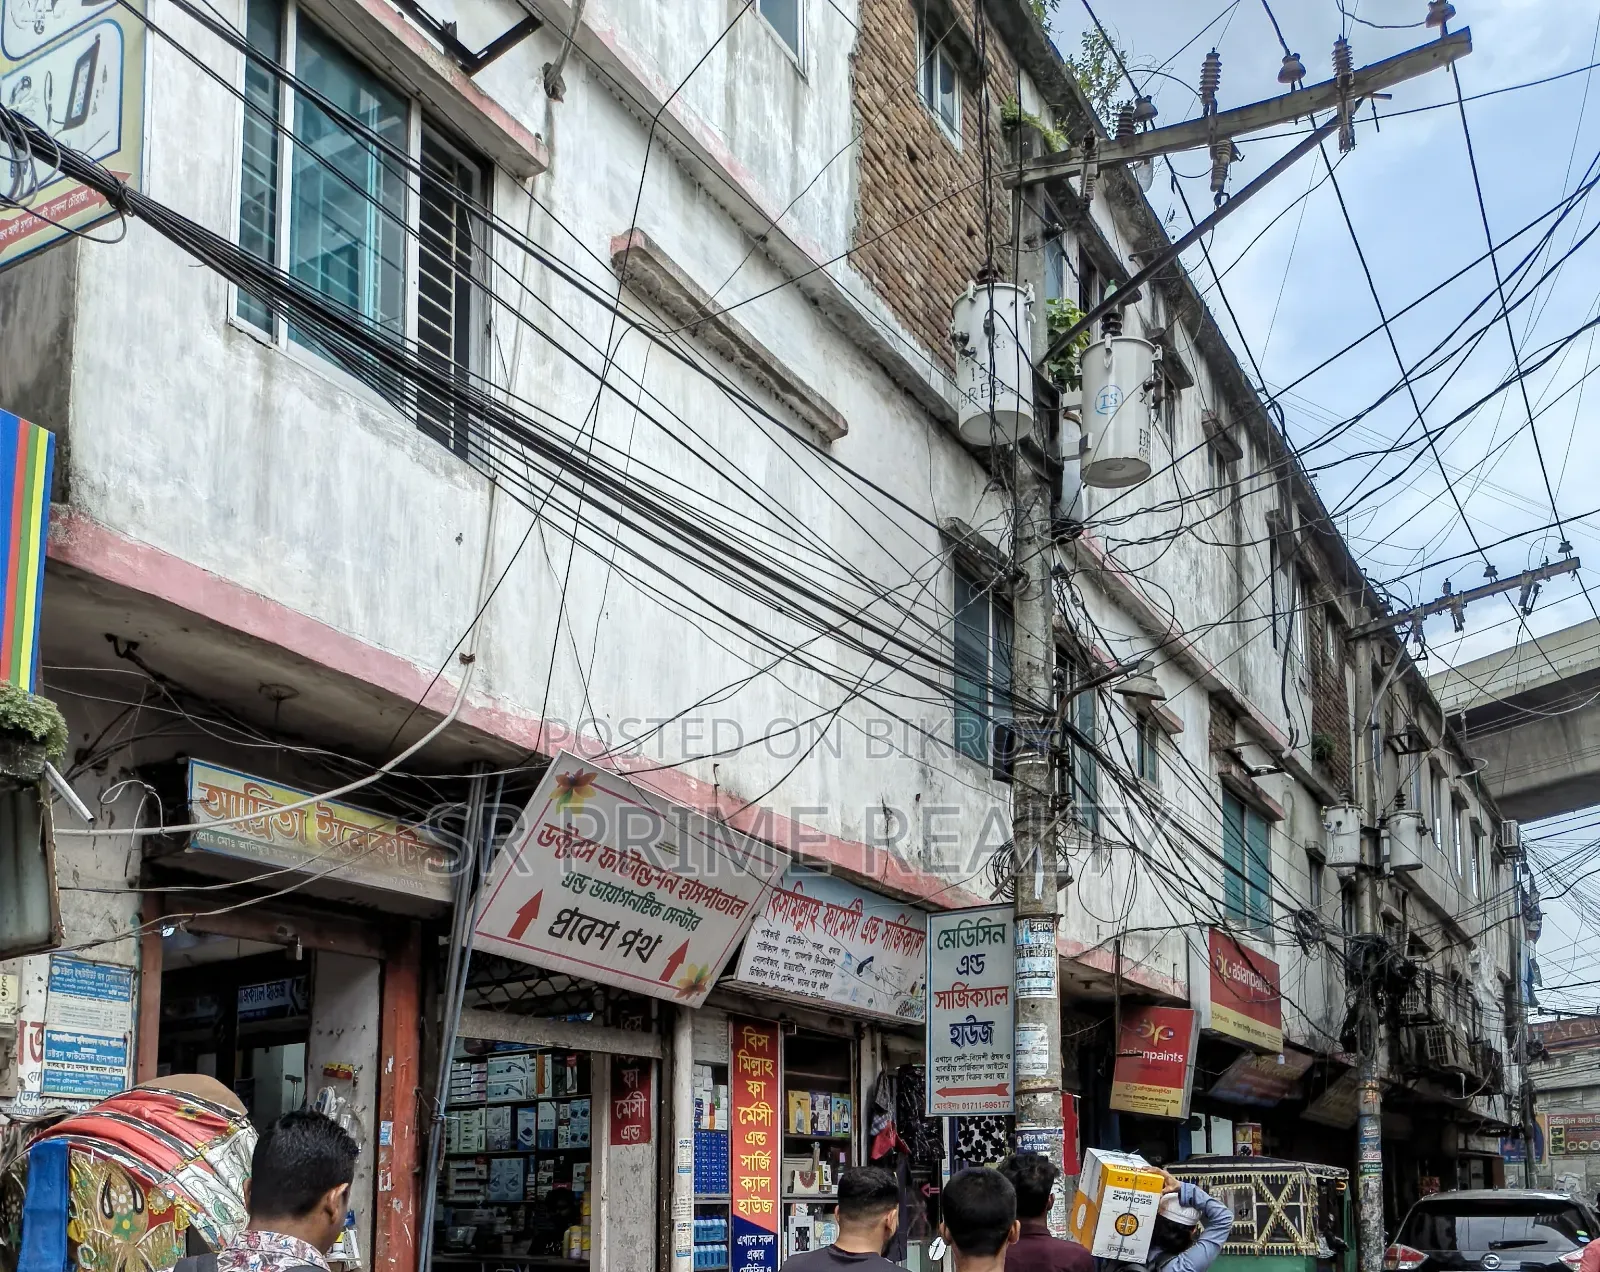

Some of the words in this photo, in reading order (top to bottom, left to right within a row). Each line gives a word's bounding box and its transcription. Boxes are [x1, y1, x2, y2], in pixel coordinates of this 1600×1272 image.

[678, 875, 749, 920] হাসপাতাল
[662, 907, 703, 932] সেন্টার
[548, 907, 620, 951] প্রবেশ
[617, 927, 663, 963] পথ
[937, 917, 1006, 950] মেডিসিন
[956, 953, 986, 976] এন্ড
[934, 981, 1010, 1010] সার্জিক্যাল
[742, 1025, 769, 1052] বিস
[949, 1015, 995, 1049] হাউজ
[737, 1049, 774, 1078] মিল্লাহ
[934, 1054, 953, 1063] এখানে
[622, 1068, 639, 1089] ফা
[983, 1073, 995, 1081] করা
[746, 1079, 765, 1101] ফা
[741, 1150, 772, 1173] সার্জি
[740, 1176, 771, 1194] ক্যাল
[737, 1195, 774, 1216] হাউজ
[737, 1234, 757, 1246] এখানে
[758, 1234, 774, 1246] সকল
[747, 1249, 765, 1261] প্রকার
